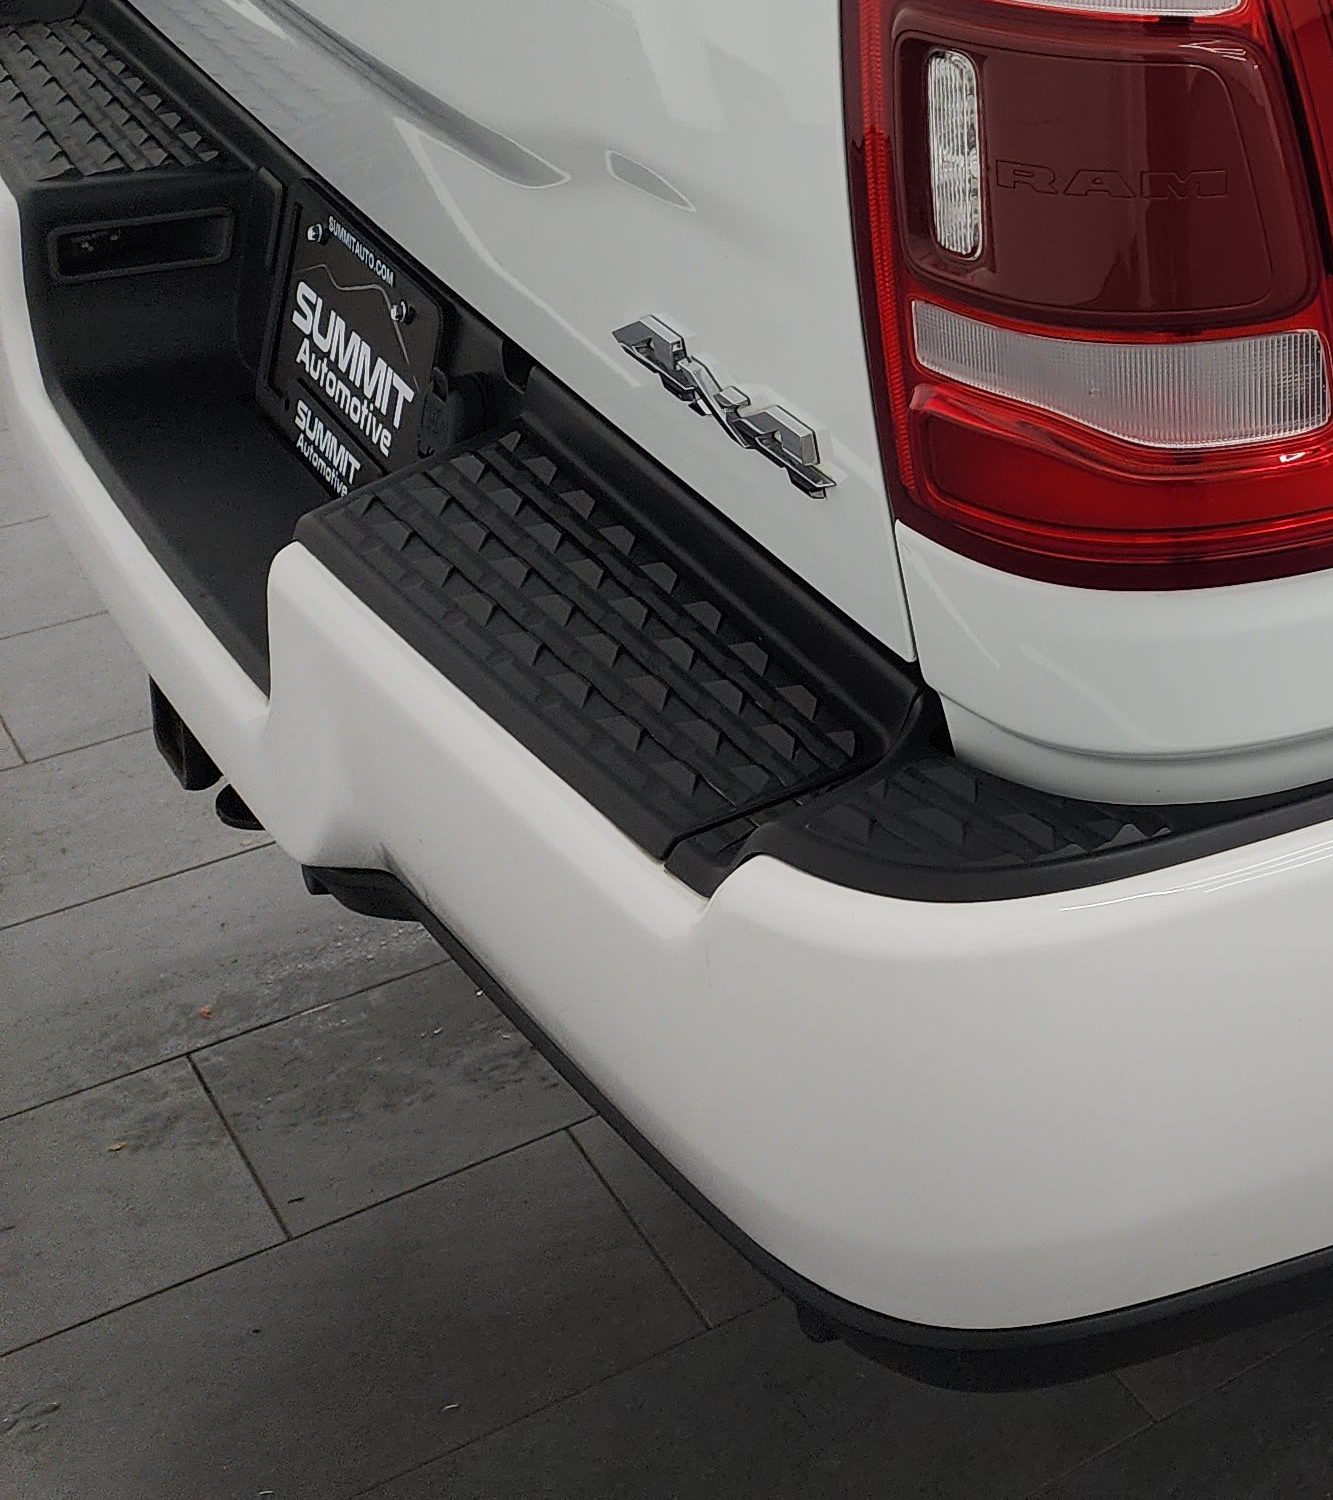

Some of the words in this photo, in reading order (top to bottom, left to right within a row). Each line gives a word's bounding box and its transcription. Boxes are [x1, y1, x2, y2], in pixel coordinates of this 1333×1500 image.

[996, 159, 1228, 200] RAM
[327, 214, 394, 287] SUMMITAUTO.COM
[292, 281, 415, 430] SUMMIT
[296, 338, 391, 457] Automotive
[295, 400, 361, 484] SUMMIT
[296, 433, 348, 497] Automotive
